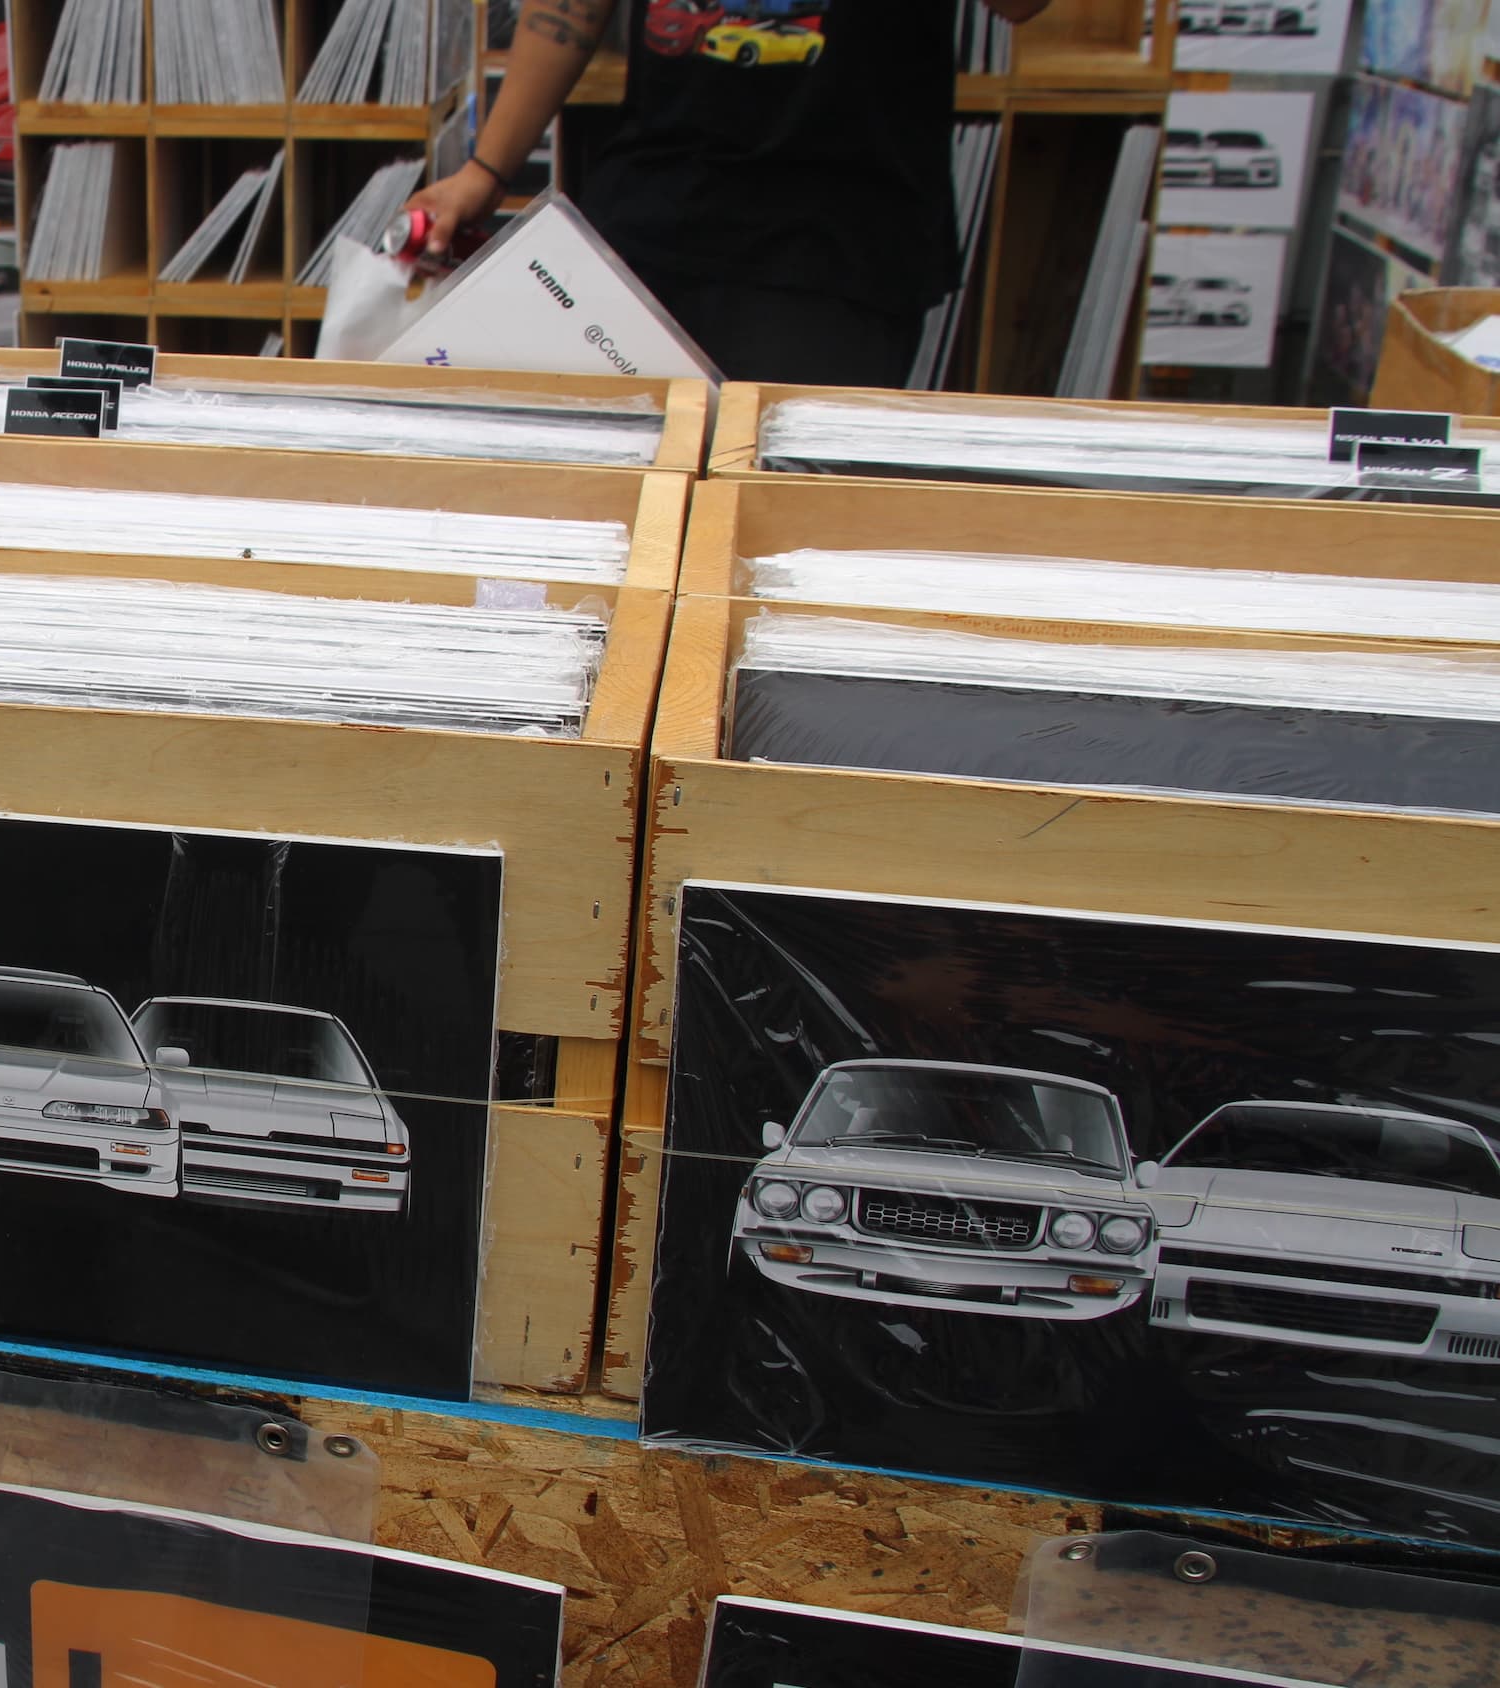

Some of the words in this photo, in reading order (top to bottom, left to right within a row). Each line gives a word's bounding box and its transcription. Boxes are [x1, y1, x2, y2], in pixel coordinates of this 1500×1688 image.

[529, 260, 575, 309] venmo
[66, 359, 104, 370] HONDA
[105, 363, 150, 375] PRELUDE
[10, 409, 49, 418] HONDA
[51, 411, 97, 420] ACCORD
[1429, 467, 1469, 482] Z
